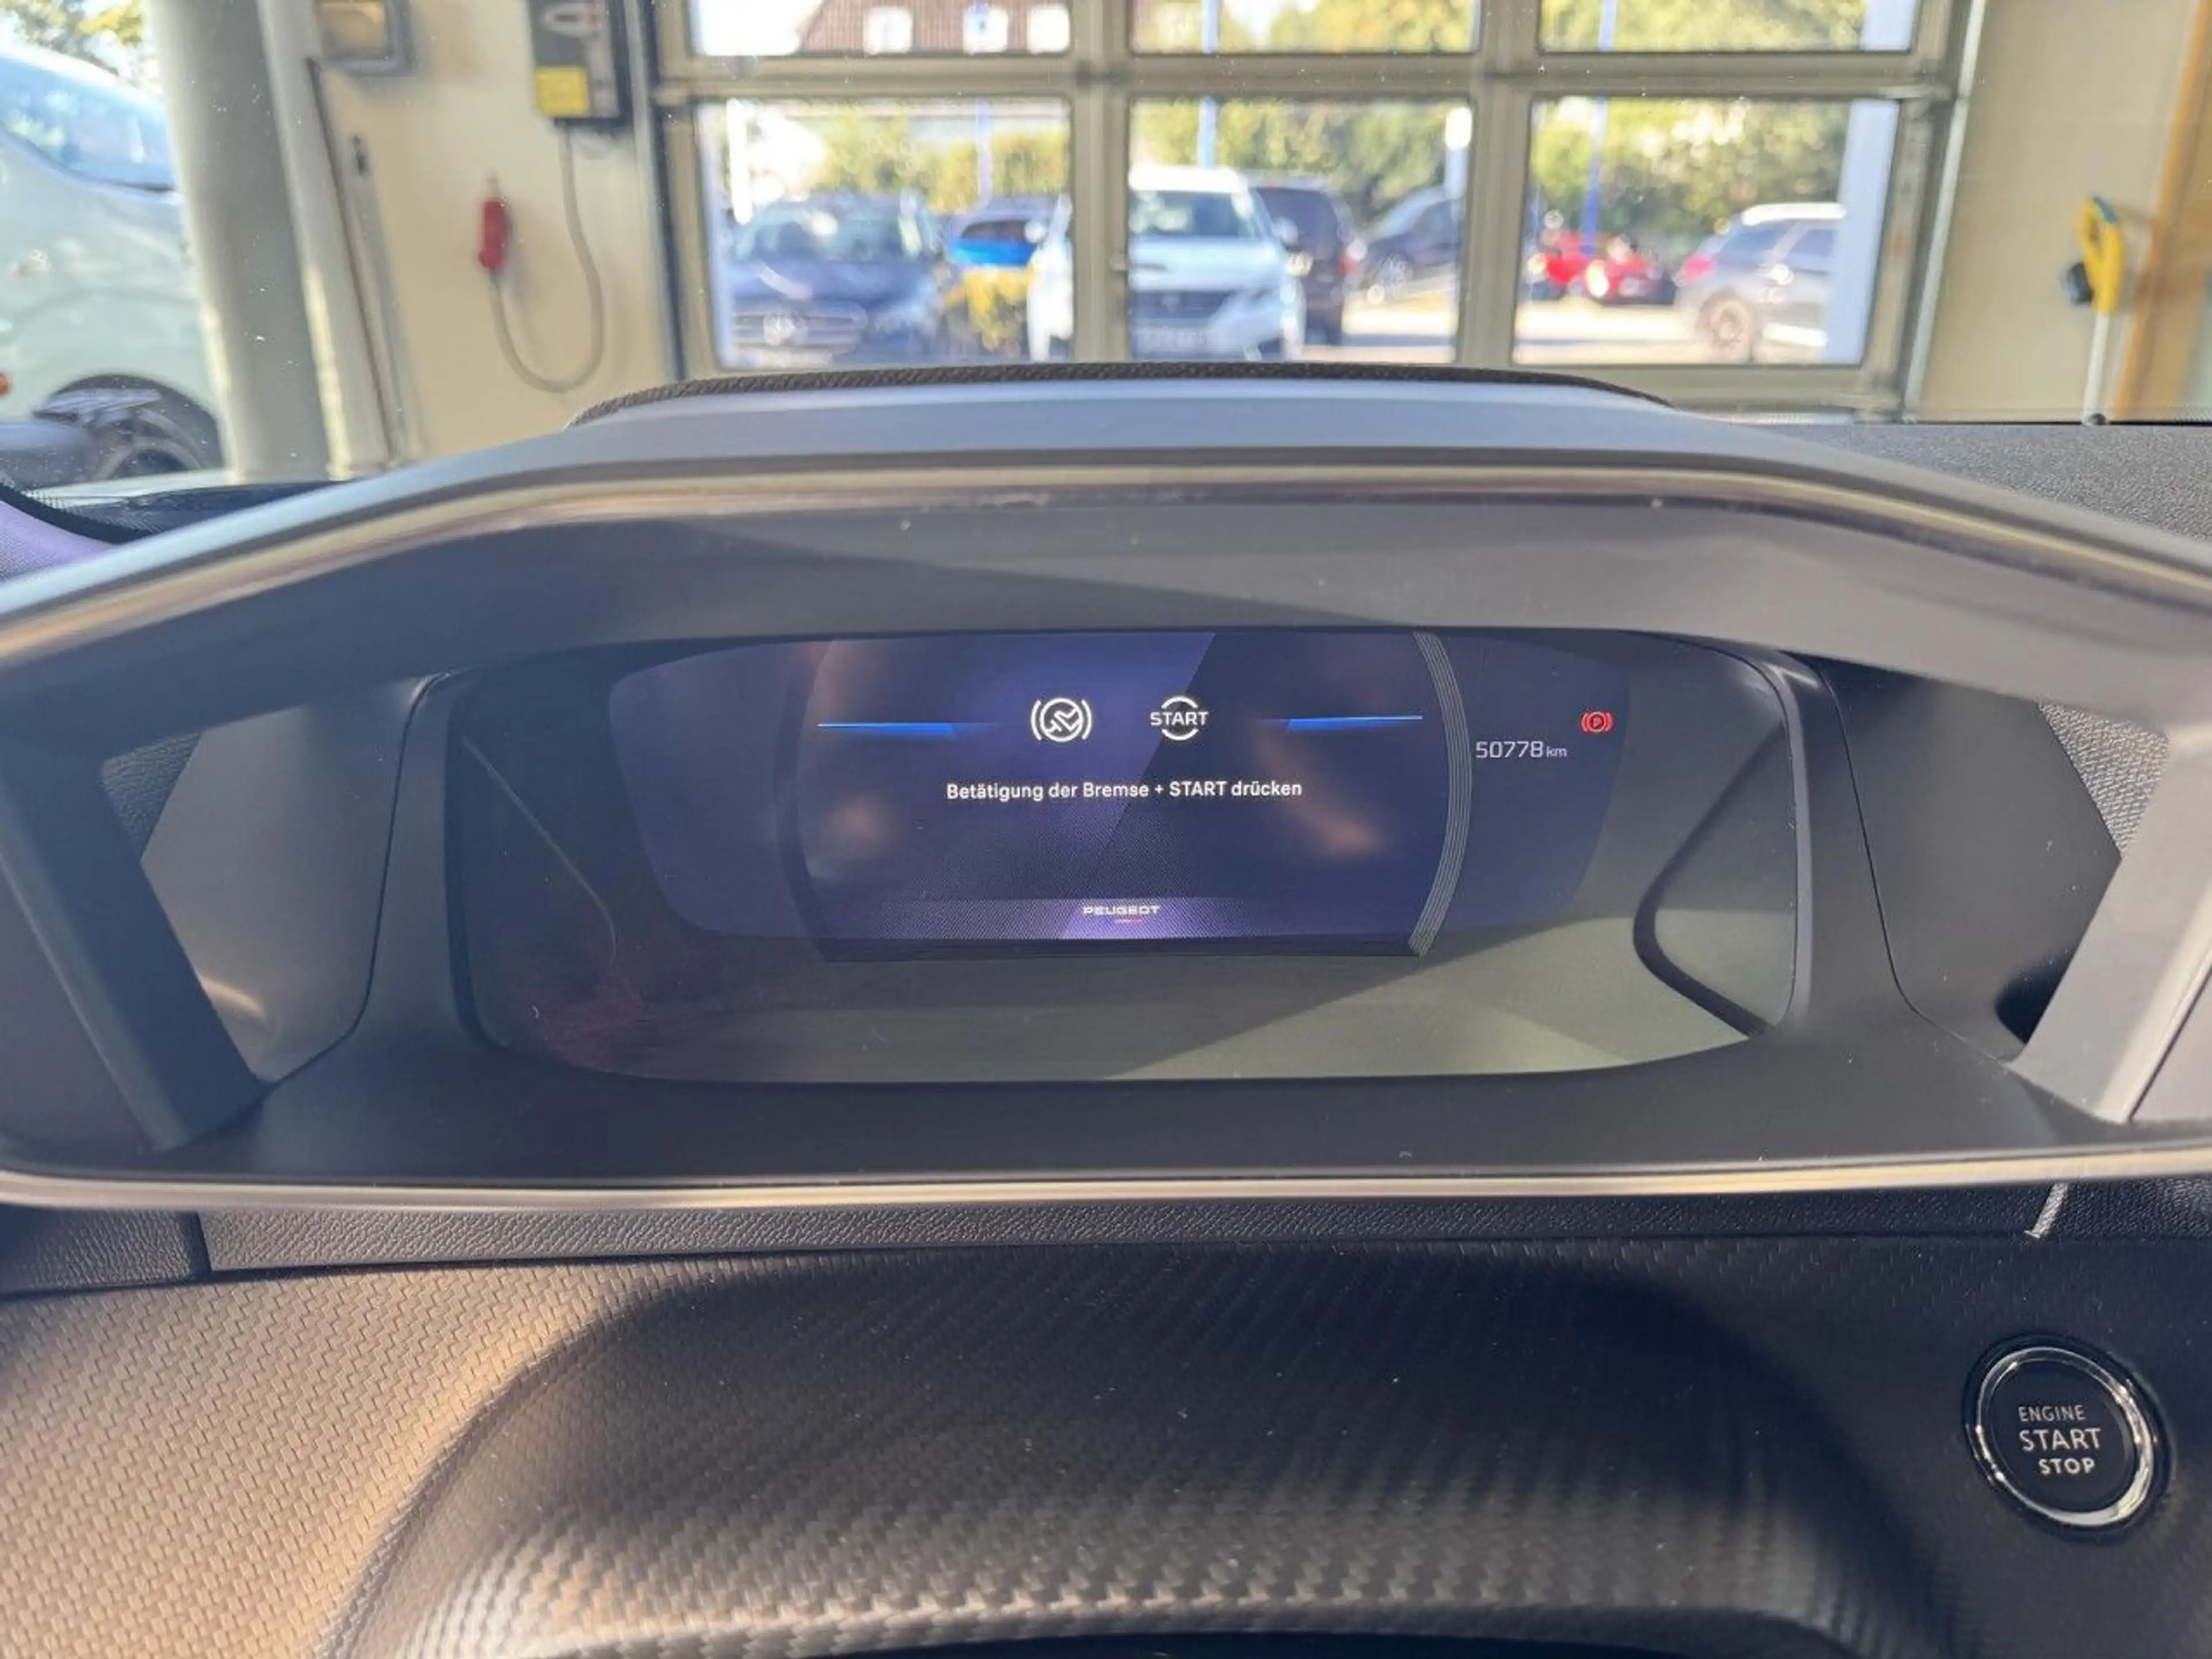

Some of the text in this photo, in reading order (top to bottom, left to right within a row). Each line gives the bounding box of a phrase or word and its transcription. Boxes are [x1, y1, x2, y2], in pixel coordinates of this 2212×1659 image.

[1150, 711, 1209, 726] START
[1475, 740, 1567, 759] 50778 km
[946, 781, 1302, 803] Betätigung der Bremse + START drücken
[1083, 905, 1161, 915] PEUGEOT
[2018, 1404, 2086, 1422] ENGINE
[2019, 1427, 2101, 1452] START
[2038, 1457, 2096, 1475] STOP
